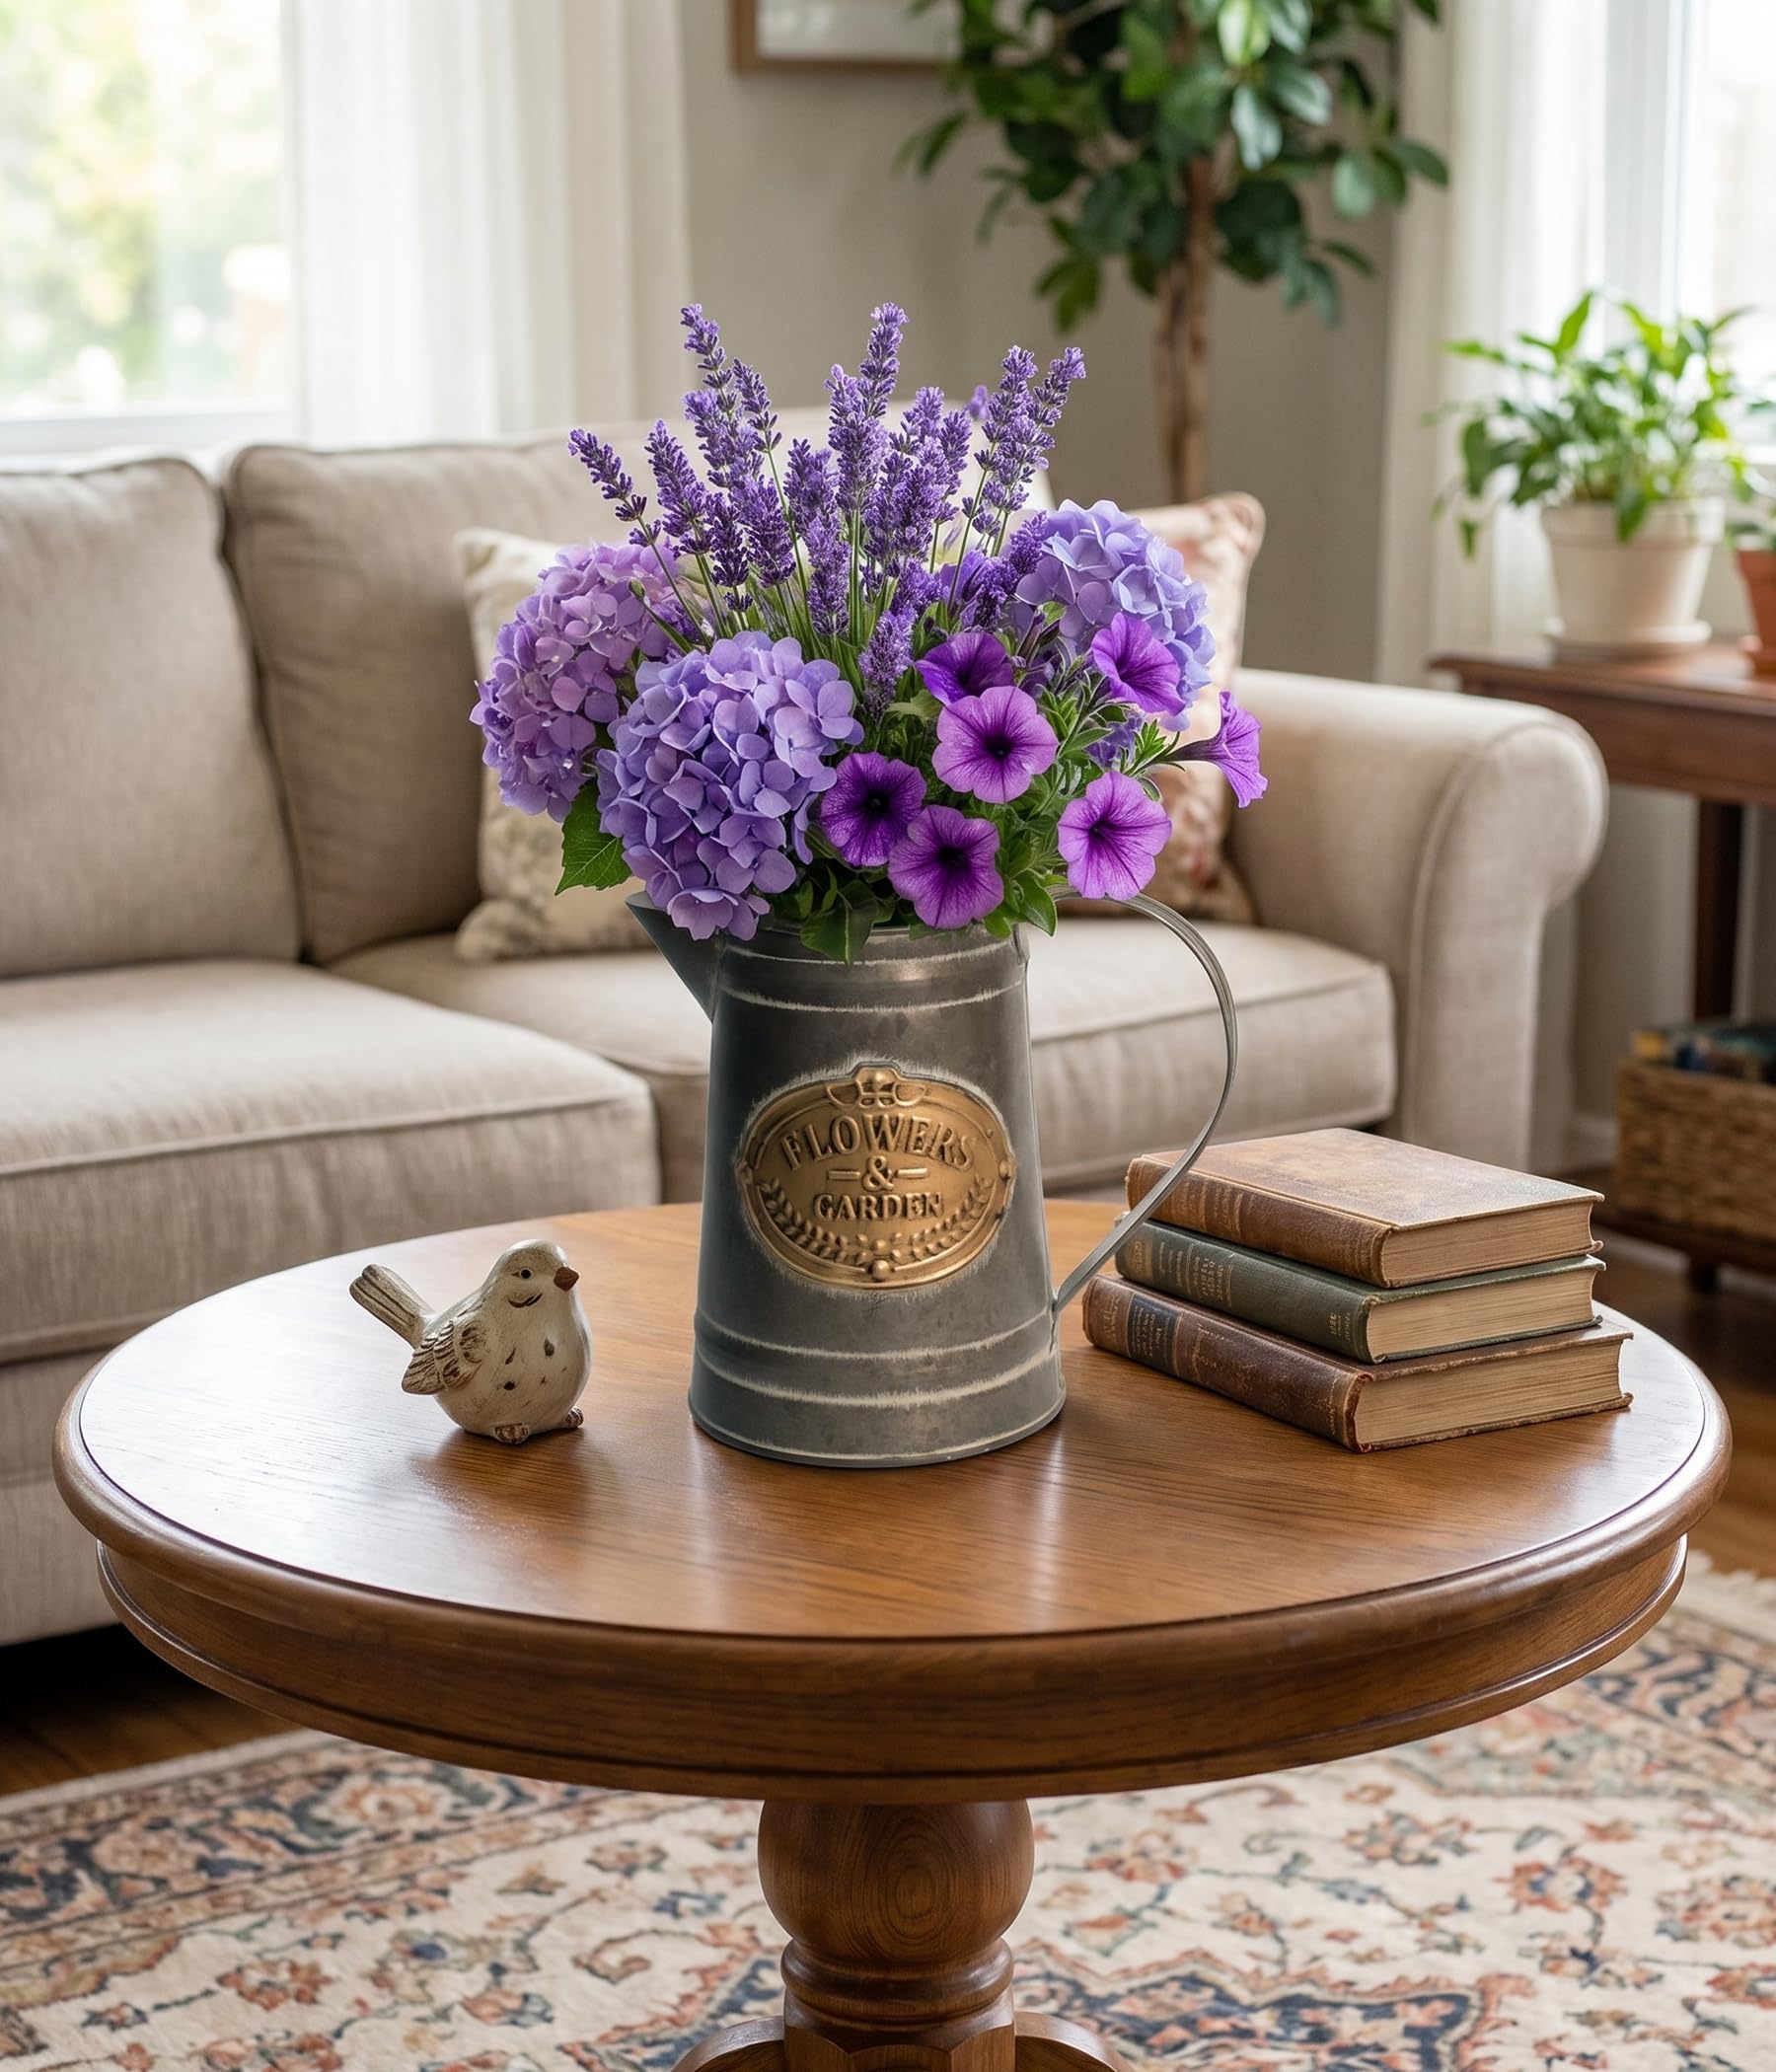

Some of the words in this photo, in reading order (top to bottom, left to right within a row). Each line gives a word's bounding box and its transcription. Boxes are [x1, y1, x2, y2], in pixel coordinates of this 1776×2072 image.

[779, 1113, 974, 1172] FLOWERS
[862, 1154, 895, 1192] &
[813, 1192, 944, 1221] GARDEN
